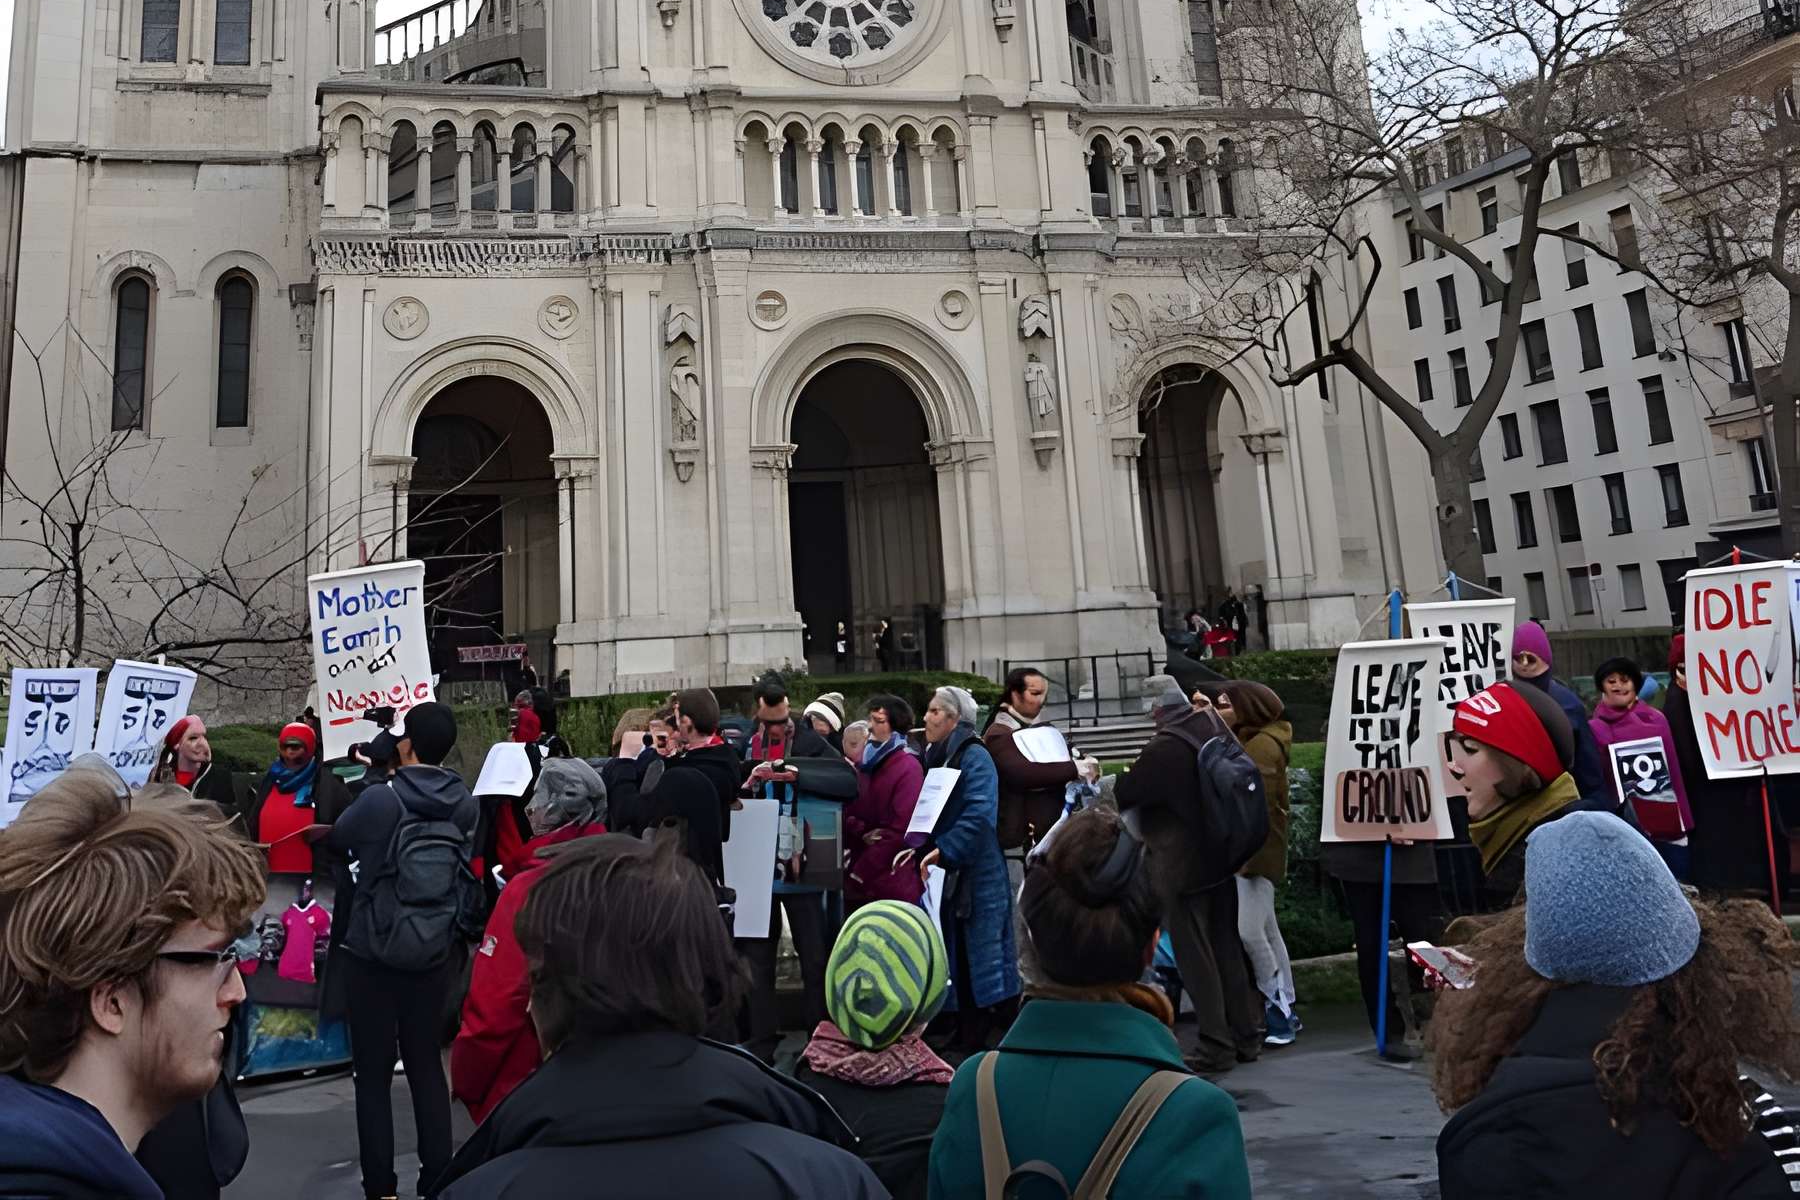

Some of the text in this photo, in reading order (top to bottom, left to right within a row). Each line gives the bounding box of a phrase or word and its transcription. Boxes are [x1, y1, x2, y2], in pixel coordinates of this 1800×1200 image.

[318, 581, 418, 620] Mother
[1694, 581, 1772, 632] IDLE
[1698, 649, 1763, 696] NO
